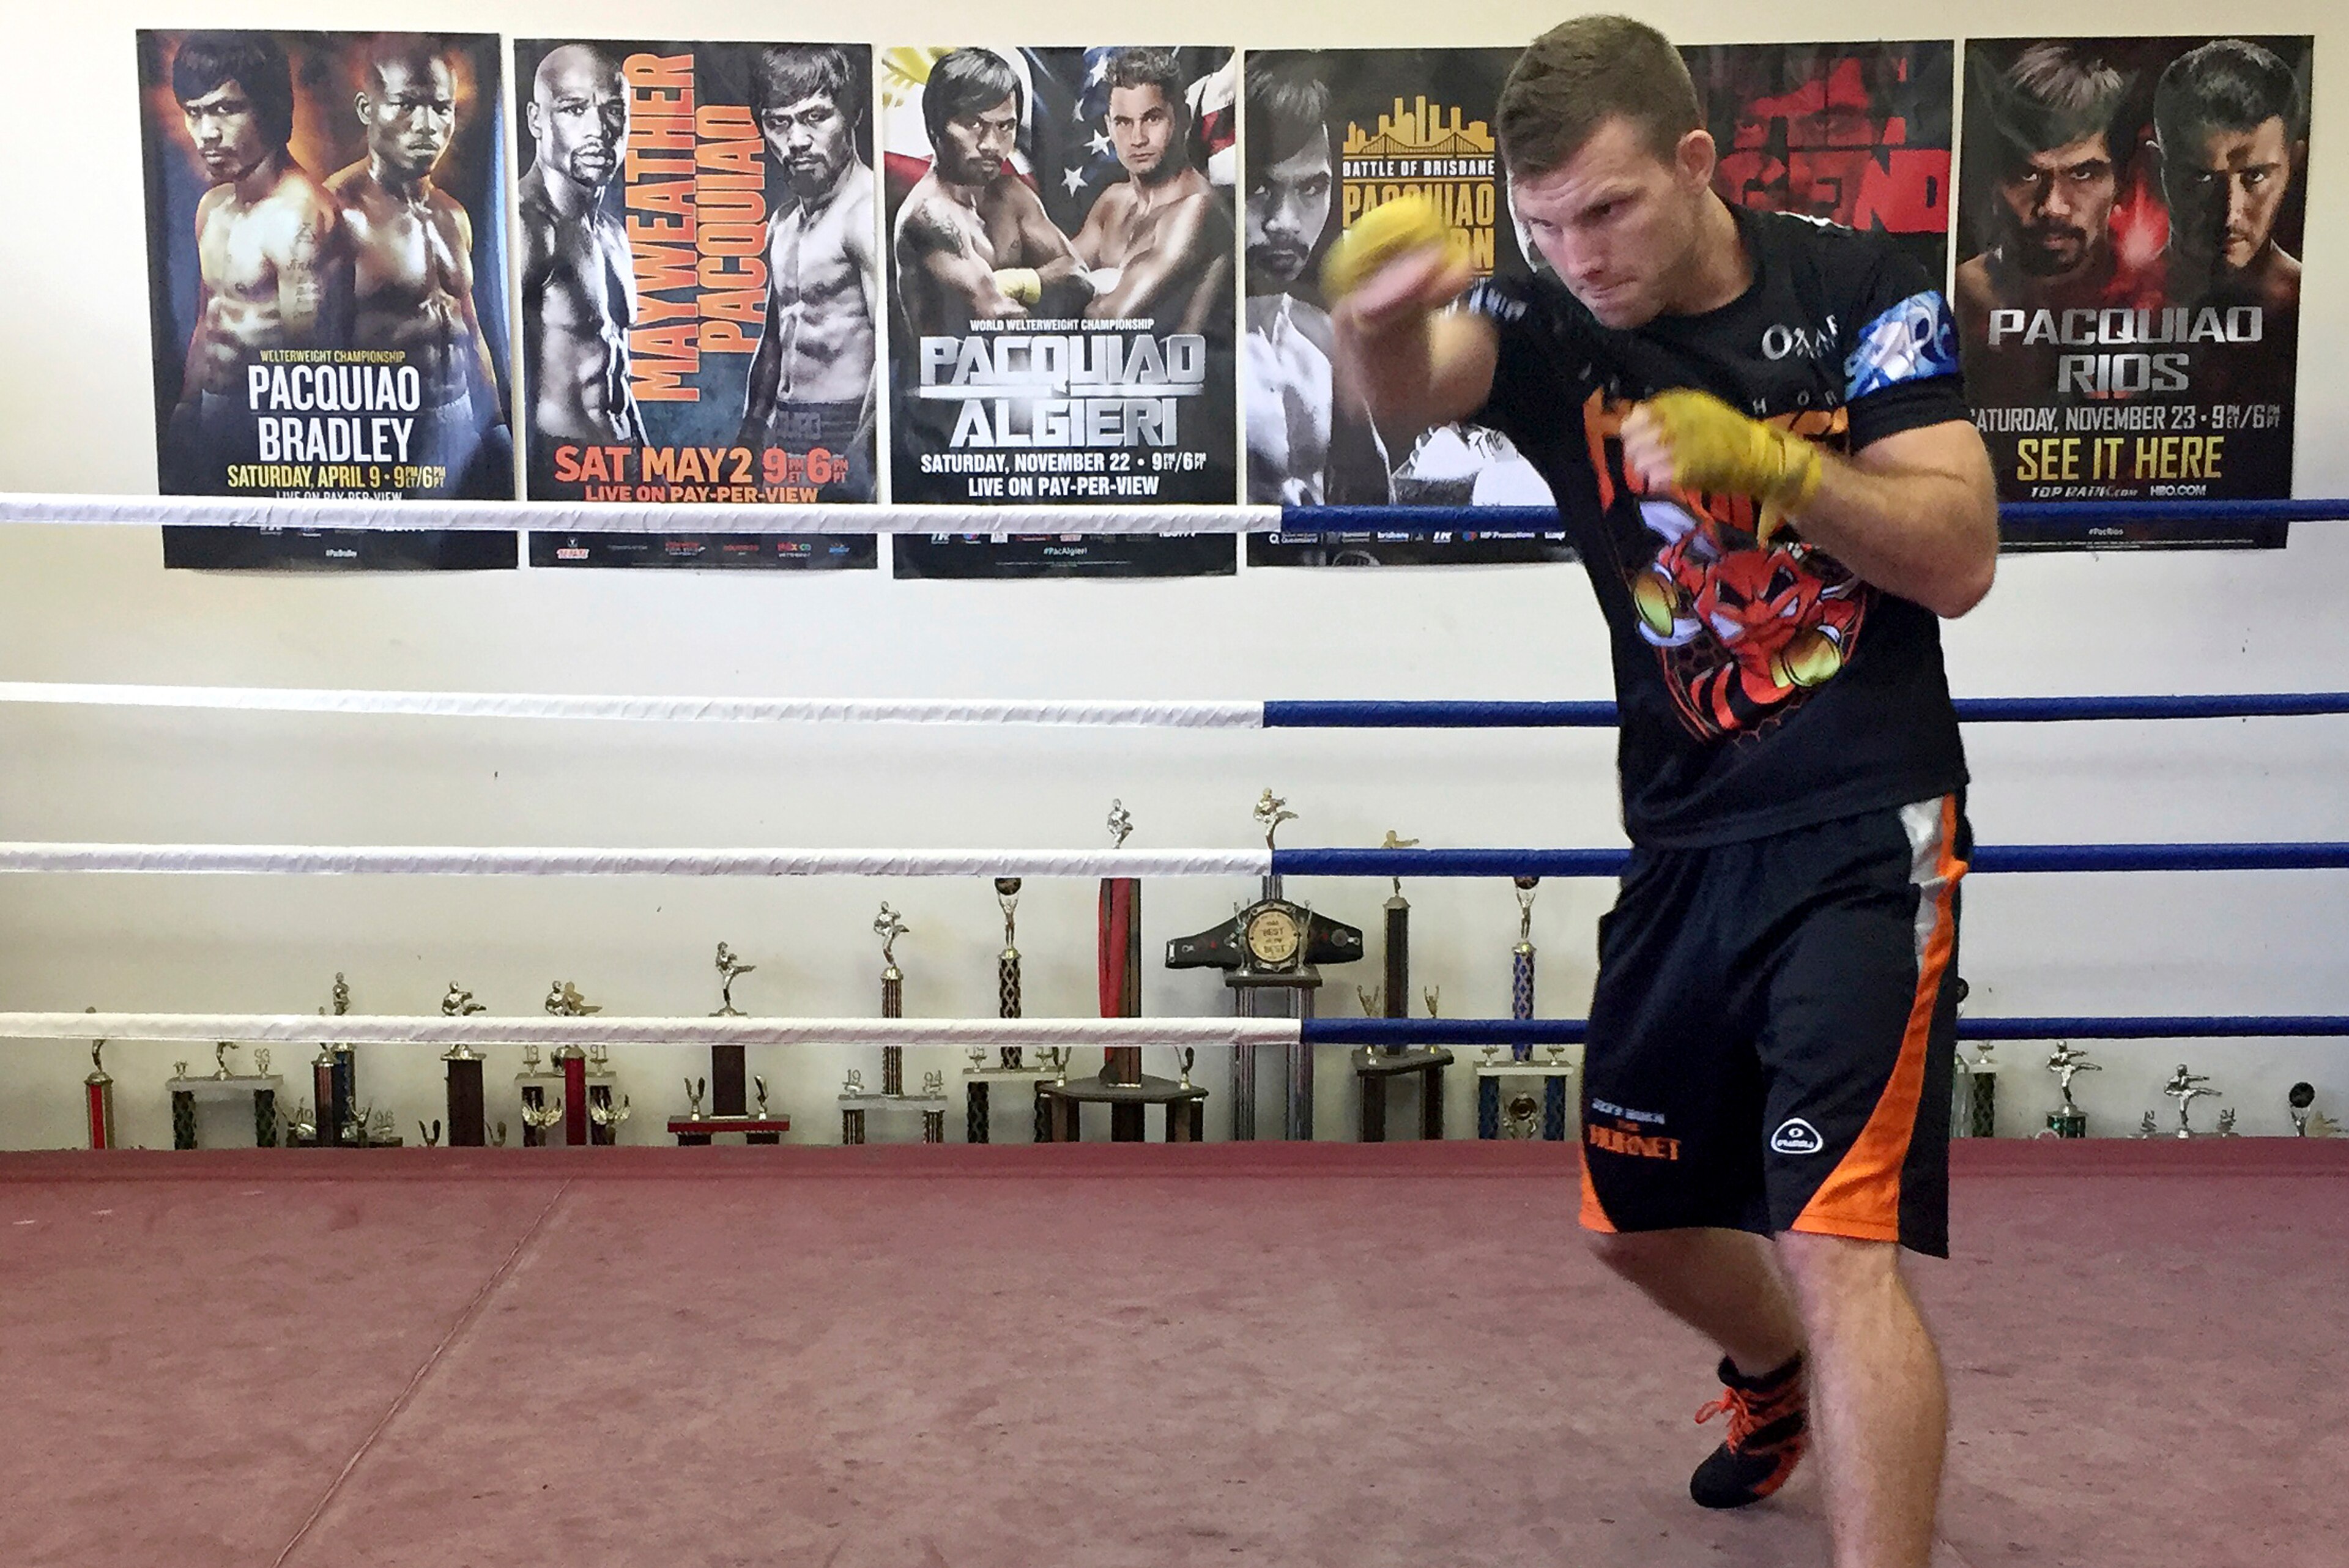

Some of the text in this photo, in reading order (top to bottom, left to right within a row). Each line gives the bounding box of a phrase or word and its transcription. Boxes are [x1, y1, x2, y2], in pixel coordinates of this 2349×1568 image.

[1342, 160, 1495, 177] BATTLE OF BRISBANE
[623, 53, 700, 401] MAYWEATHER
[695, 105, 768, 354] PACQUIAO
[970, 318, 1155, 332] WORLD WELTERWEIGHT CHAMPIONSHIP
[1987, 307, 2263, 346] PACQUIAO
[259, 349, 406, 364] WELTERWEIGHT CHAMPIONSHIP
[919, 334, 1206, 387] PACQUIAO
[2057, 352, 2189, 393] RIOS
[248, 365, 421, 412] PACQUIAO
[949, 398, 1178, 448] ALGIERI
[1971, 406, 2059, 434] ATURDAY,
[2065, 406, 2166, 432] NOVEMBER
[2171, 405, 2196, 430] 23
[258, 416, 415, 463] BRADLEY
[2016, 435, 2225, 481] SEE IT HERE
[227, 464, 314, 489] SATURDAY,
[317, 465, 366, 488] APRIL
[369, 465, 380, 488] 9
[554, 445, 632, 482] SAT
[642, 446, 728, 483] MAY
[729, 447, 754, 483] 2
[921, 453, 1010, 475] SATURDAY,
[1014, 453, 1105, 473] NOVEMBER
[1109, 453, 1131, 472] 22
[584, 485, 818, 503] LIVE ON PAY-PER-VIEW
[967, 476, 1160, 497] LIVE ON PAY-PER-VIEW
[2150, 485, 2206, 497] HBO.COM
